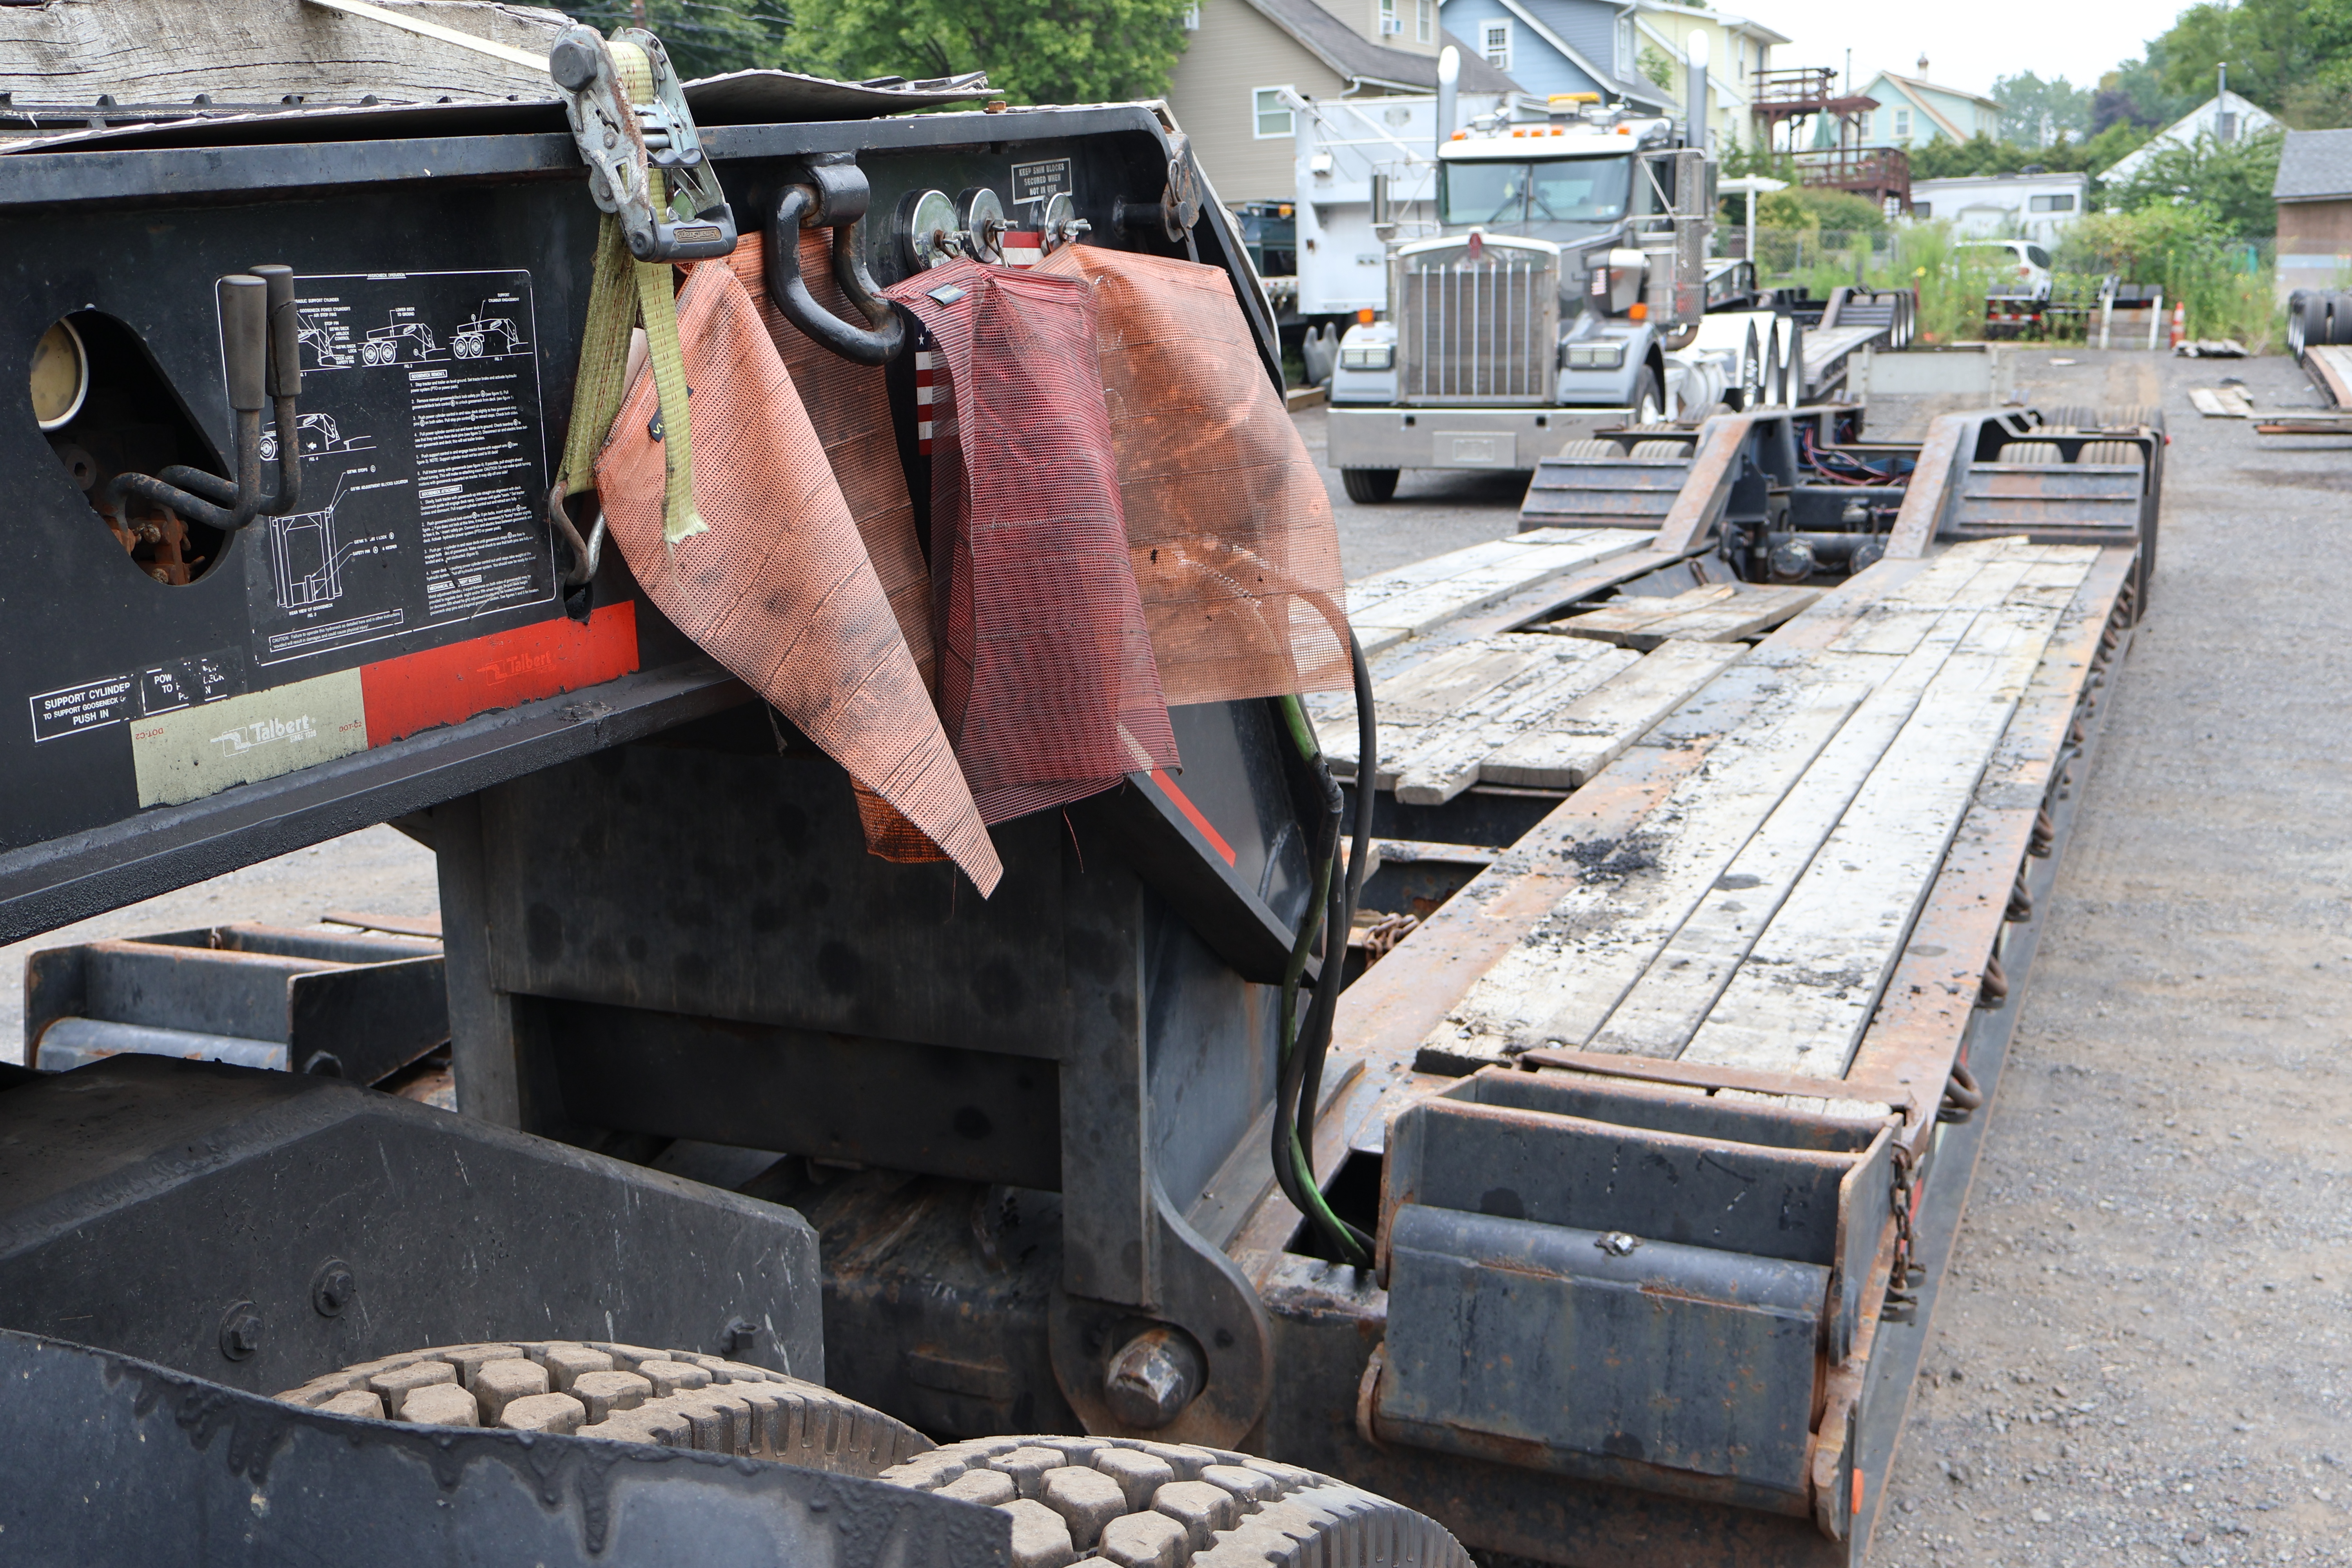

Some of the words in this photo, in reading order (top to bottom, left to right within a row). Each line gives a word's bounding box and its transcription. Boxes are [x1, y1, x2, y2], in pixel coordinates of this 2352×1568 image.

[1019, 167, 1031, 176] KEEP
[1033, 165, 1045, 174] SHIM
[1046, 163, 1064, 173] BLOCKS
[1024, 176, 1046, 186] SECURED
[1048, 173, 1061, 182] WHEN
[1029, 187, 1039, 196] NOT
[1047, 184, 1056, 192] USE
[677, 230, 715, 239] SmartStraps
[506, 651, 551, 673] Talbert
[154, 674, 172, 684] POW
[162, 684, 172, 693] TO
[44, 692, 86, 710] SUPPORT
[54, 706, 81, 718] SUPPORT
[82, 697, 118, 711] GOOSENECK
[73, 714, 97, 725] PUSH
[100, 709, 109, 719] IN
[249, 714, 309, 742] Talbert
[339, 722, 362, 732] DOT-C2
[136, 728, 164, 740] DOT-C2
[290, 733, 304, 742] SINCE
